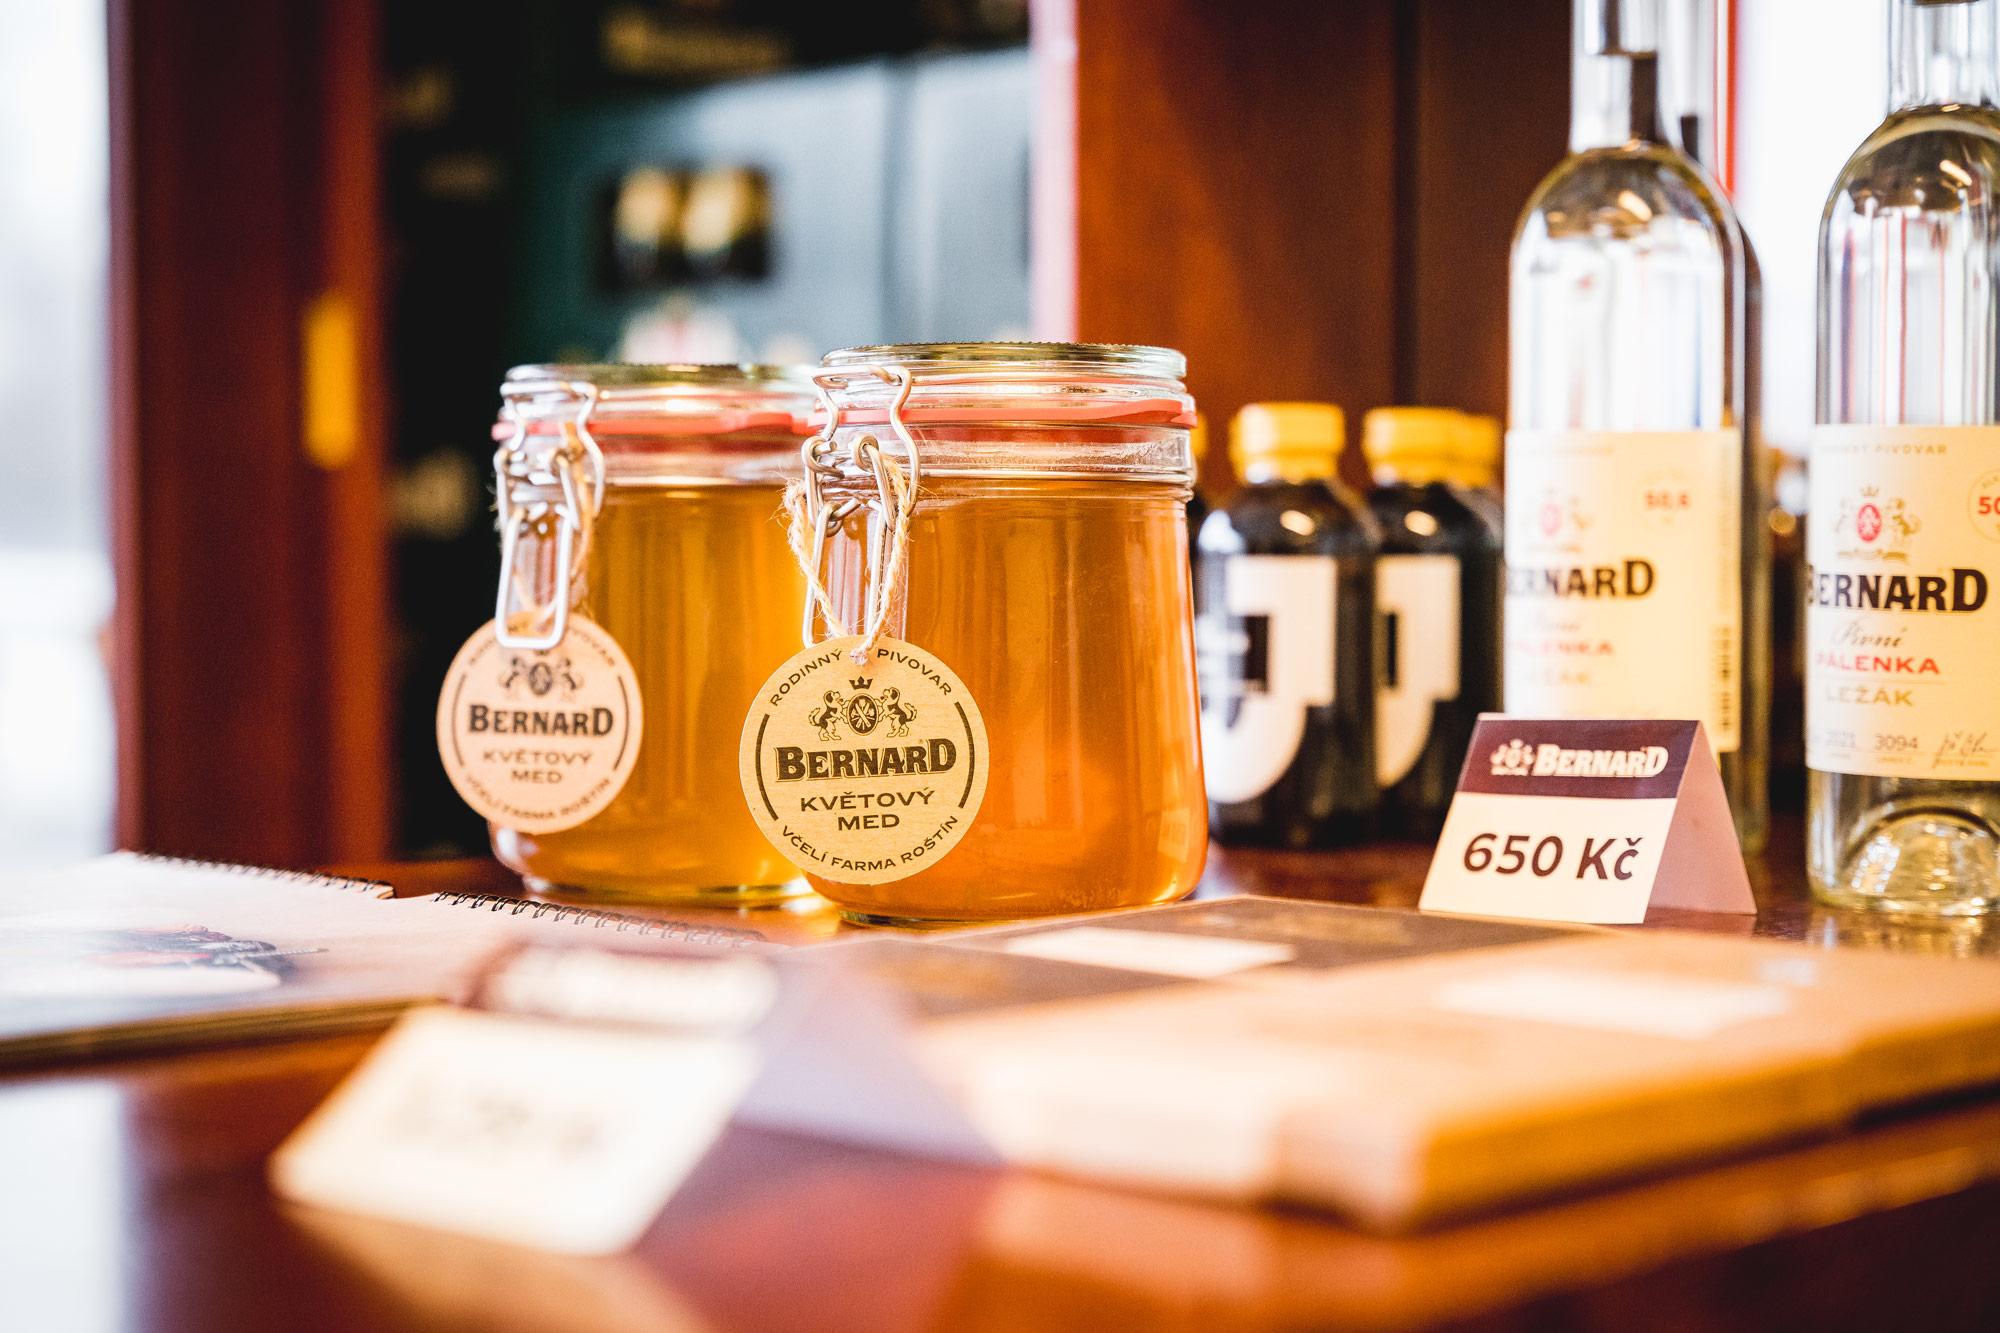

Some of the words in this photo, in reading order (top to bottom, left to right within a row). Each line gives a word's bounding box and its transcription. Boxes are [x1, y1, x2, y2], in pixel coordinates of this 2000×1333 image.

[1808, 567, 1988, 613] ERNARD
[770, 648, 842, 707] RODINNÝ
[877, 648, 952, 696] PIVOVAR
[468, 704, 614, 736] BERNARD
[1873, 732, 1919, 752] 3094
[511, 769, 563, 784] MED
[774, 738, 957, 783] BERNARD
[1531, 744, 1669, 777] BERNARD
[800, 787, 935, 812] KVĚTOVÝ
[838, 814, 900, 831] MED
[782, 825, 828, 863] VČELÍ
[831, 856, 896, 872] FARMA
[901, 816, 959, 864] ROŠTÍN
[1463, 833, 1564, 877] 650
[1576, 836, 1645, 881] Kč
